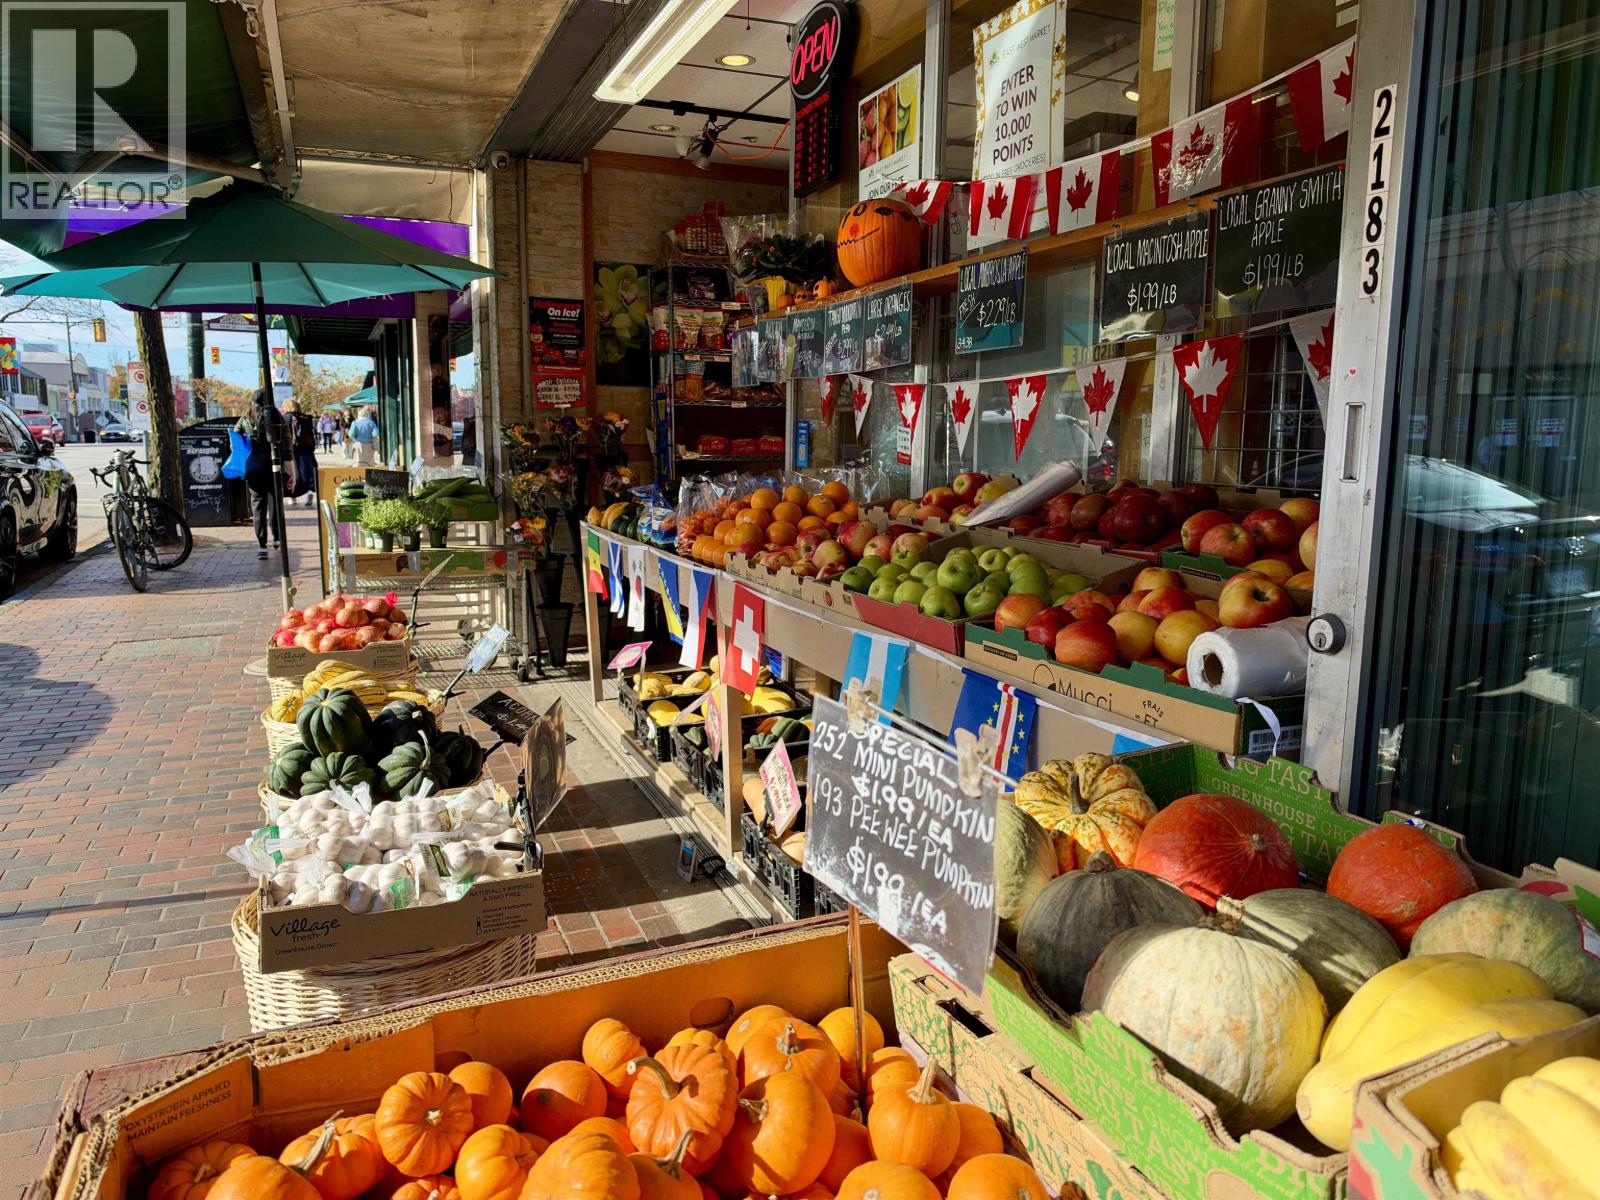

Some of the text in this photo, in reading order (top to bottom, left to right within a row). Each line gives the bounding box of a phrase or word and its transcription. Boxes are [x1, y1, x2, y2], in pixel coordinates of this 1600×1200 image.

[791, 15, 837, 86] OPEN
[1029, 24, 1051, 45] MARKET
[1001, 64, 1035, 97] ENTER
[996, 86, 1038, 121] TO WIN
[995, 112, 1032, 143] 10,000
[993, 135, 1034, 165] POINTS
[879, 181, 890, 195] OUR
[1218, 169, 1342, 231] LOCAL GRANNY SMITH
[1361, 88, 1394, 296] 2183
[1251, 218, 1285, 247] APPLE
[1106, 241, 1135, 274] LOCAL
[1182, 228, 1208, 260] APPLE
[547, 307, 580, 318] On Ice!
[1127, 282, 1177, 313] $1.99/LB
[1143, 701, 1165, 718] FRAIS
[812, 720, 995, 844] 252 MINI PUMPKIN
[812, 773, 843, 818] 193
[1211, 775, 1317, 829] GREENHOUSE
[270, 917, 342, 937] Village
[191, 1080, 231, 1103] APPLIED
[127, 1090, 232, 1143] MAINTAIN FRESHNESS
